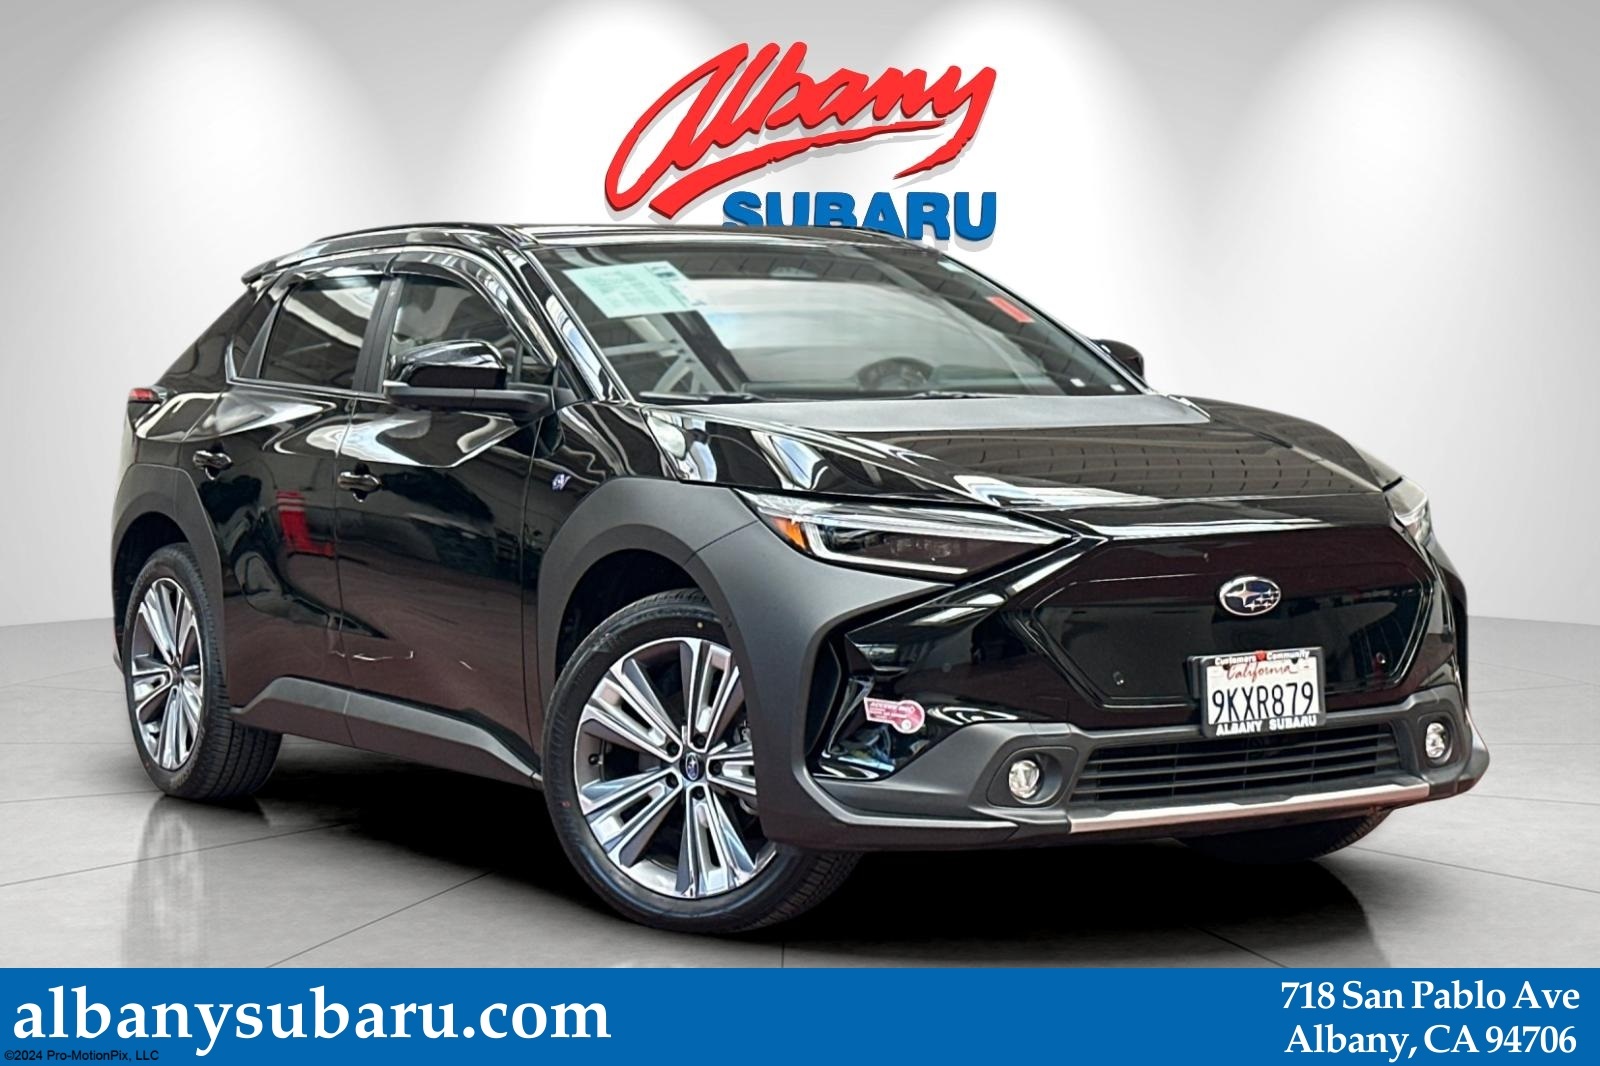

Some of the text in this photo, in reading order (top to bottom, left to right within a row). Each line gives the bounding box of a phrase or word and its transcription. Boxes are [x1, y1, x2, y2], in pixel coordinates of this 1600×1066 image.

[604, 42, 997, 211] Albany
[722, 191, 997, 241] SUBARU
[1226, 660, 1298, 682] California
[1212, 681, 1314, 723] 9KXR879
[1216, 714, 1317, 736] ALBANY SUBARU
